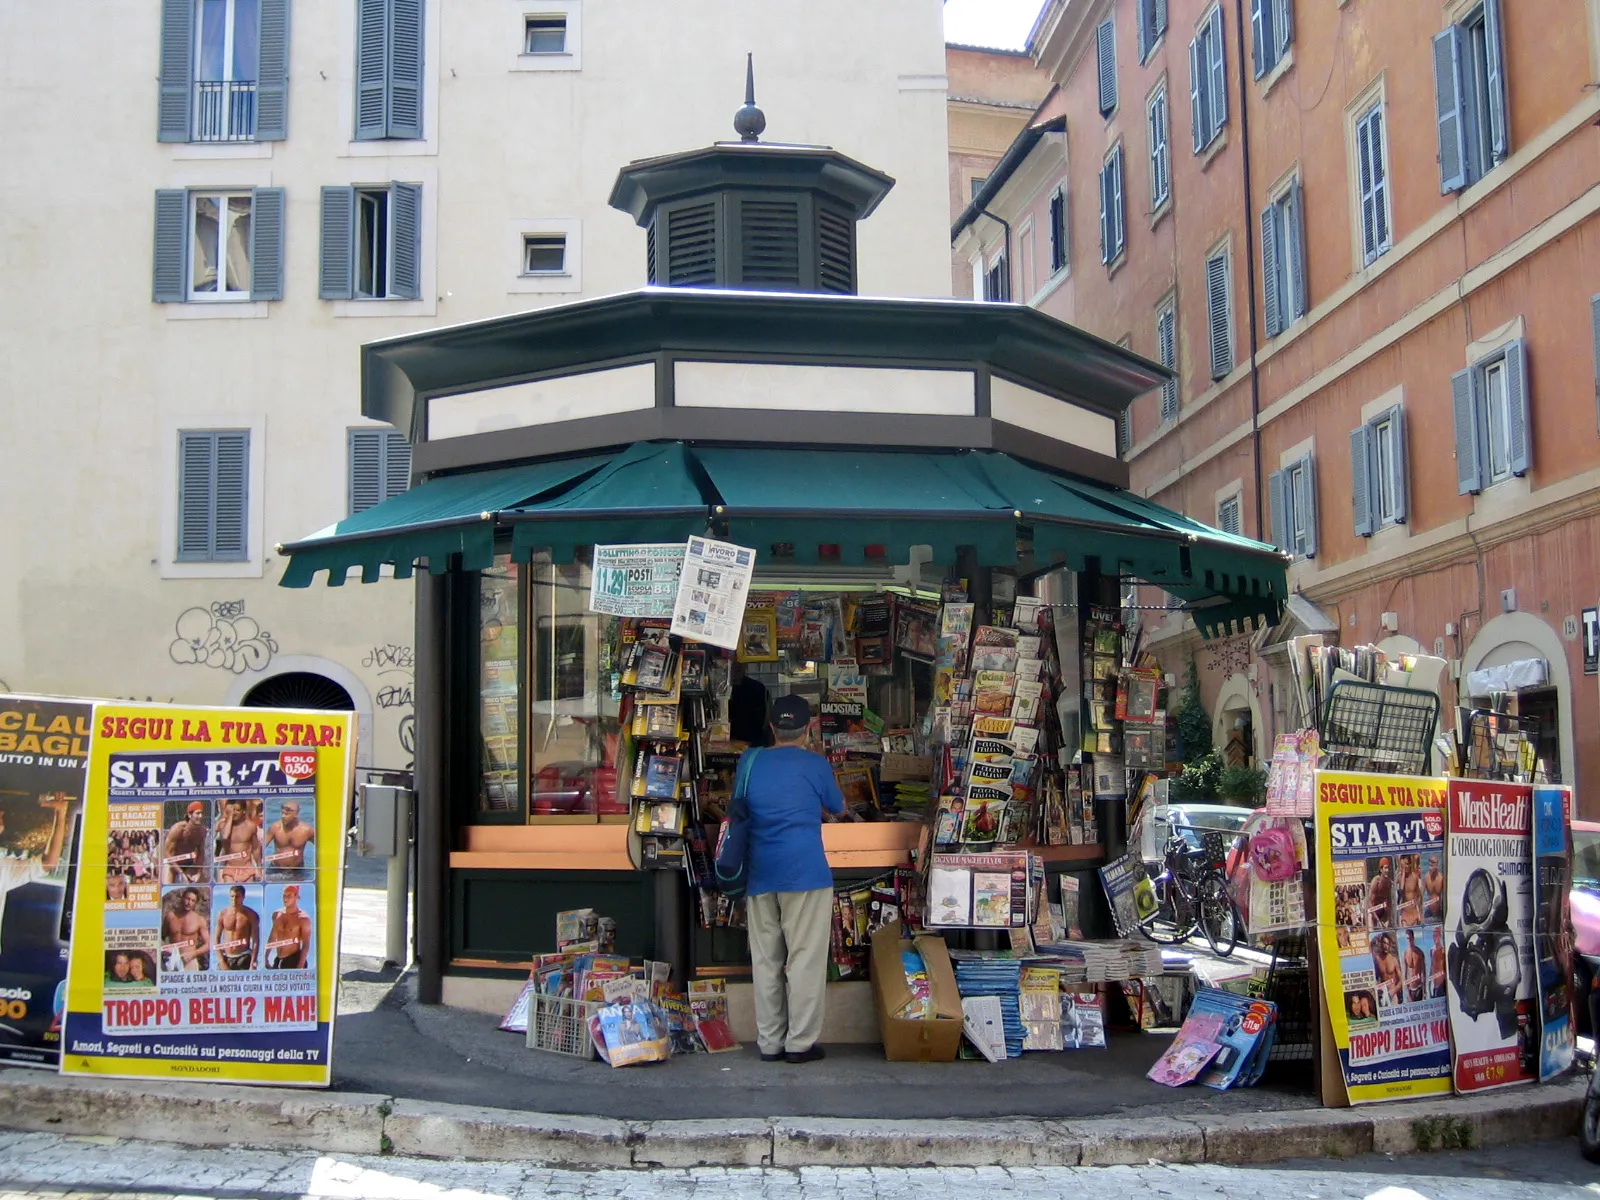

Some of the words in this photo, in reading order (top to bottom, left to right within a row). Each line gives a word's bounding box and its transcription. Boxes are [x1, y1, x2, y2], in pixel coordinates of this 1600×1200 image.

[628, 568, 653, 581] POSTI
[1583, 611, 1597, 656] T
[821, 703, 862, 716] BACKSTAGE
[101, 716, 173, 740] SEGUI
[180, 719, 211, 742] LA
[220, 721, 267, 744] TUA
[275, 723, 342, 747] STAR!
[38, 757, 53, 766] IN
[58, 758, 77, 768] UN
[284, 756, 315, 764] SOLO
[1320, 782, 1364, 804] SEGUI
[1367, 785, 1385, 805] LA
[1388, 786, 1414, 807] TUA
[1457, 791, 1490, 829] Men's
[1451, 837, 1501, 857] L'OROLOGIO
[193, 974, 207, 983] STAR
[209, 974, 218, 982] Chi
[251, 973, 261, 981] chi
[272, 972, 288, 981] dalla
[289, 971, 315, 980] terribile
[210, 985, 218, 993] LA
[219, 984, 242, 993] NOSTRA
[242, 984, 263, 992] GIURIA
[264, 984, 273, 992] HA
[104, 1000, 181, 1027] TROPPO
[189, 996, 256, 1024] BELLI?
[264, 995, 316, 1022] MAH!
[602, 1002, 644, 1018] ANA
[1349, 1030, 1391, 1060] TROPPO
[1394, 1023, 1429, 1051] BELLI?
[72, 1040, 104, 1053] Amori,
[106, 1041, 142, 1056] Segreti
[144, 1045, 150, 1054] e
[153, 1043, 198, 1057] Curiosità
[200, 1045, 216, 1056] sui
[218, 1047, 274, 1062] personaggi
[277, 1048, 304, 1060] della
[306, 1050, 319, 1061] TV
[171, 1065, 221, 1074] MONDADORI
[1350, 1071, 1373, 1083] Segreti
[1409, 1066, 1440, 1078] personaggi
